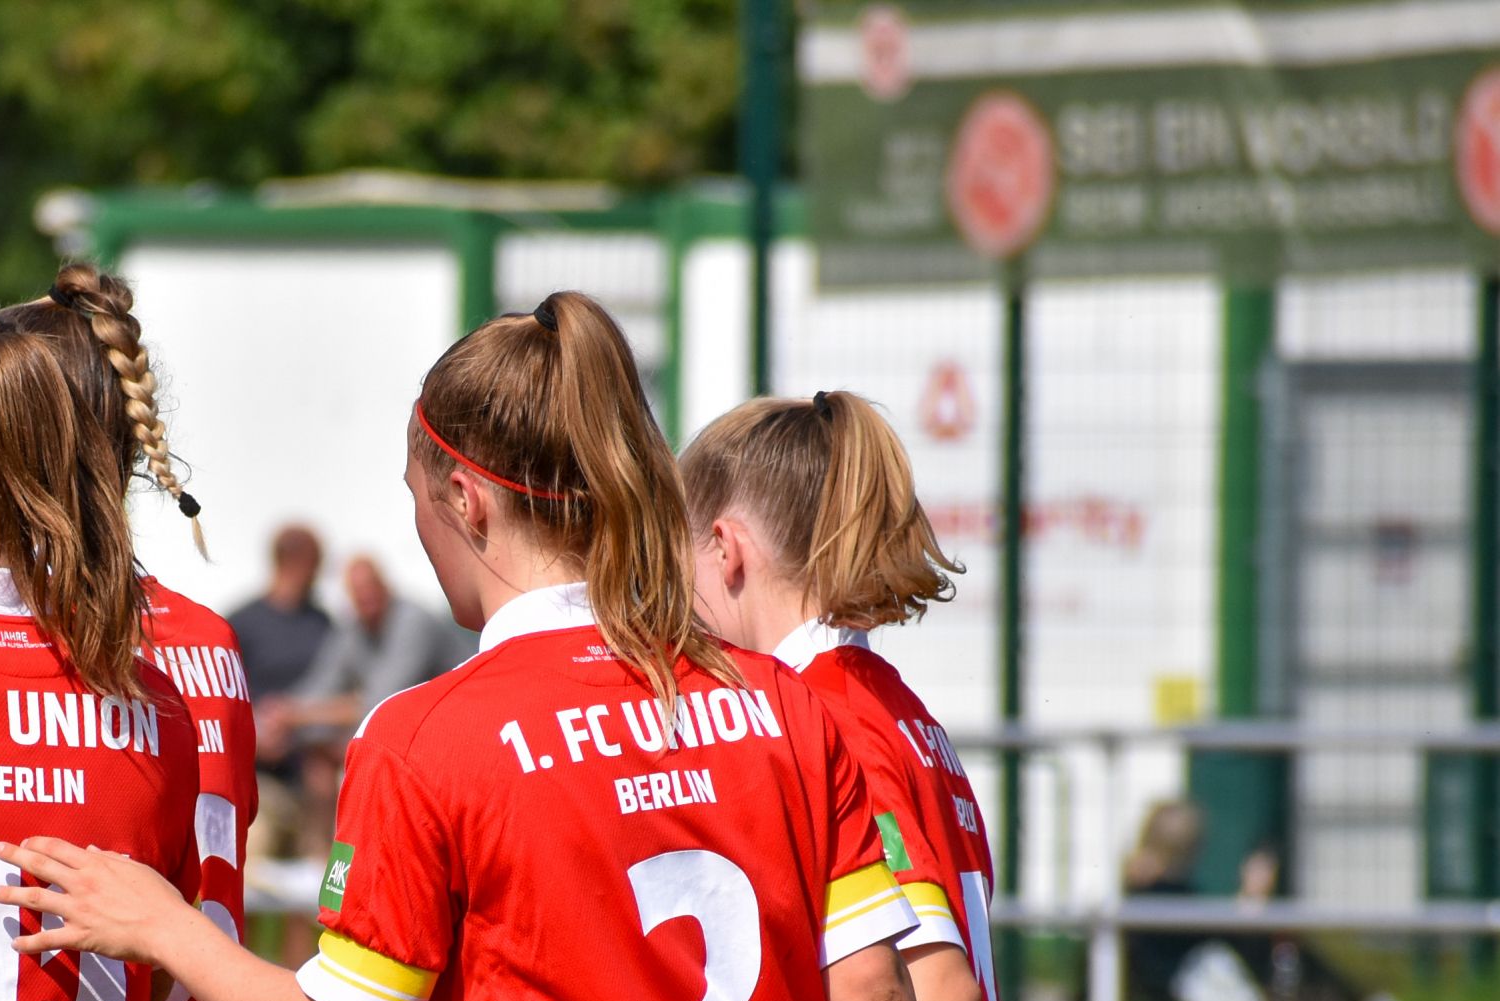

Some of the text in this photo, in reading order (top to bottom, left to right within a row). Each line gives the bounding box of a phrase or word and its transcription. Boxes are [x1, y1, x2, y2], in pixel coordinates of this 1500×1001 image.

[0, 631, 29, 643] JAHRE
[8, 690, 160, 757] UNION
[499, 687, 783, 774] 1. FC UNION
[613, 768, 718, 815] BERLIN
